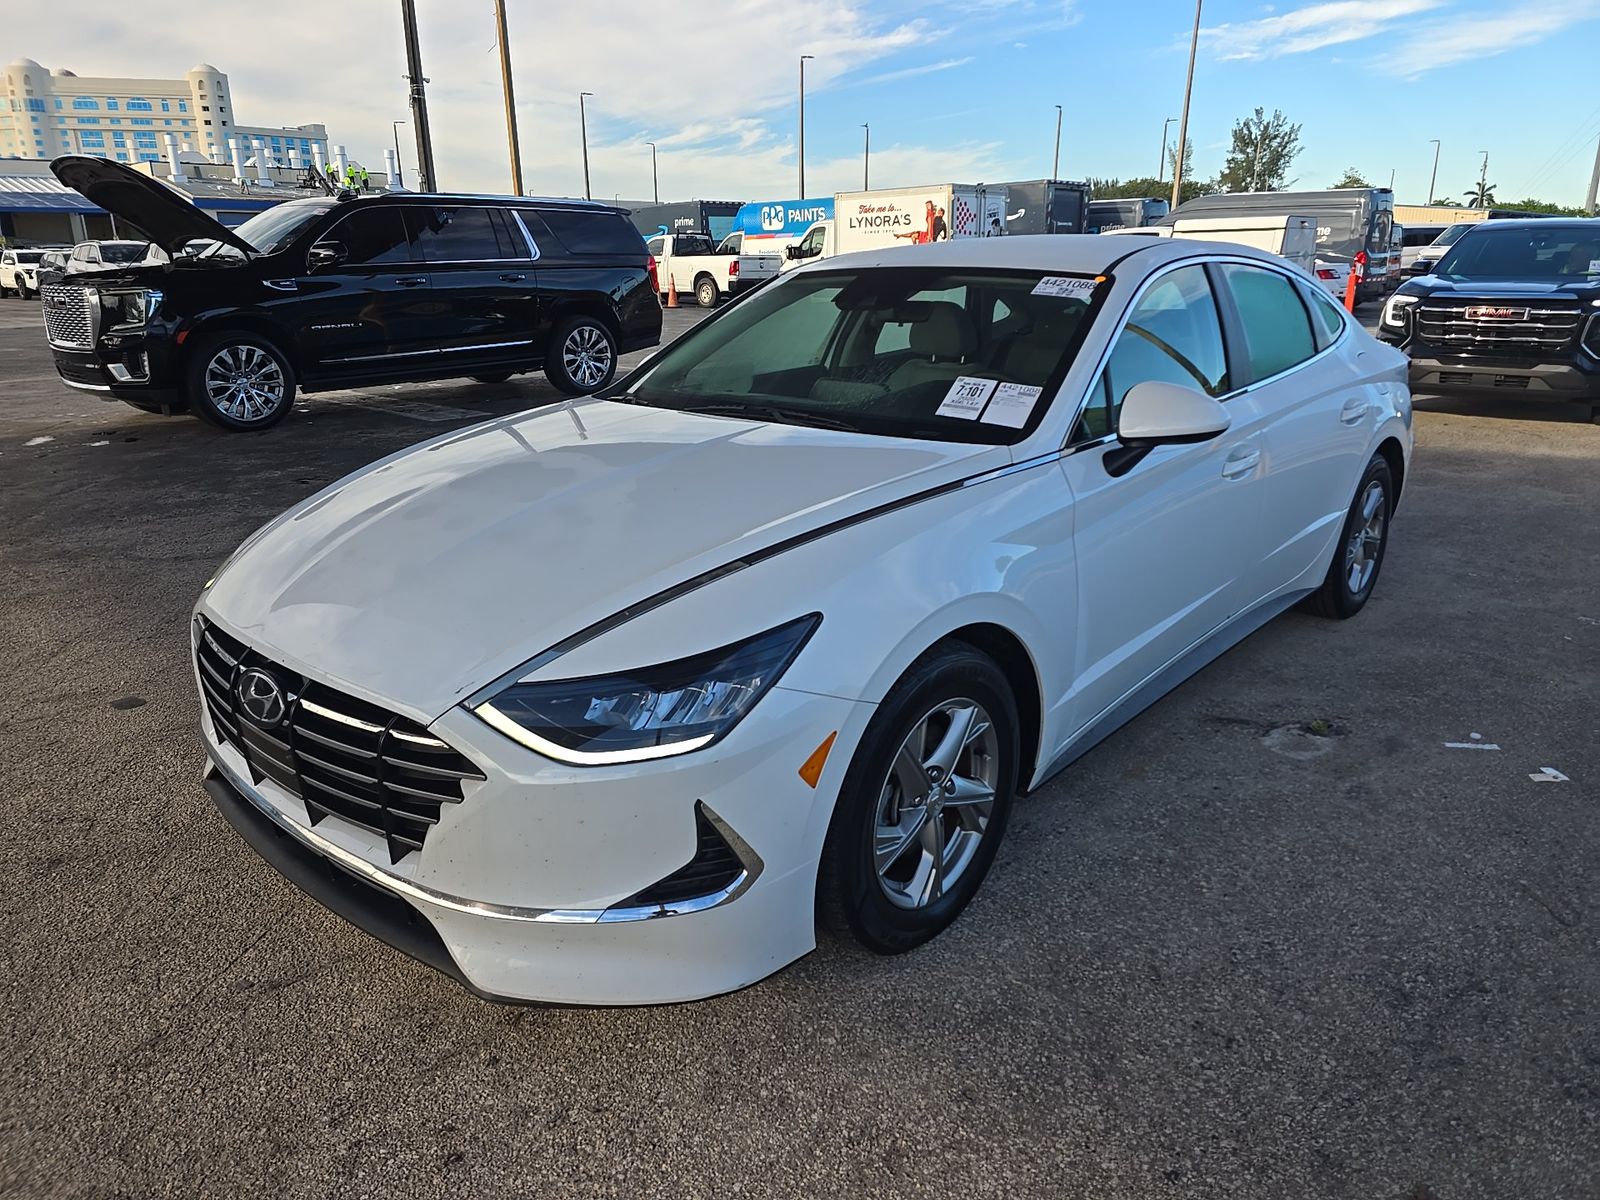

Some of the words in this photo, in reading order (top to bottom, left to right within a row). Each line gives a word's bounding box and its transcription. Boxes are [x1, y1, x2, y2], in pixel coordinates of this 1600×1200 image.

[674, 216, 695, 229] prime
[788, 207, 826, 223] PAINTS
[849, 214, 912, 229] LYNORA'S
